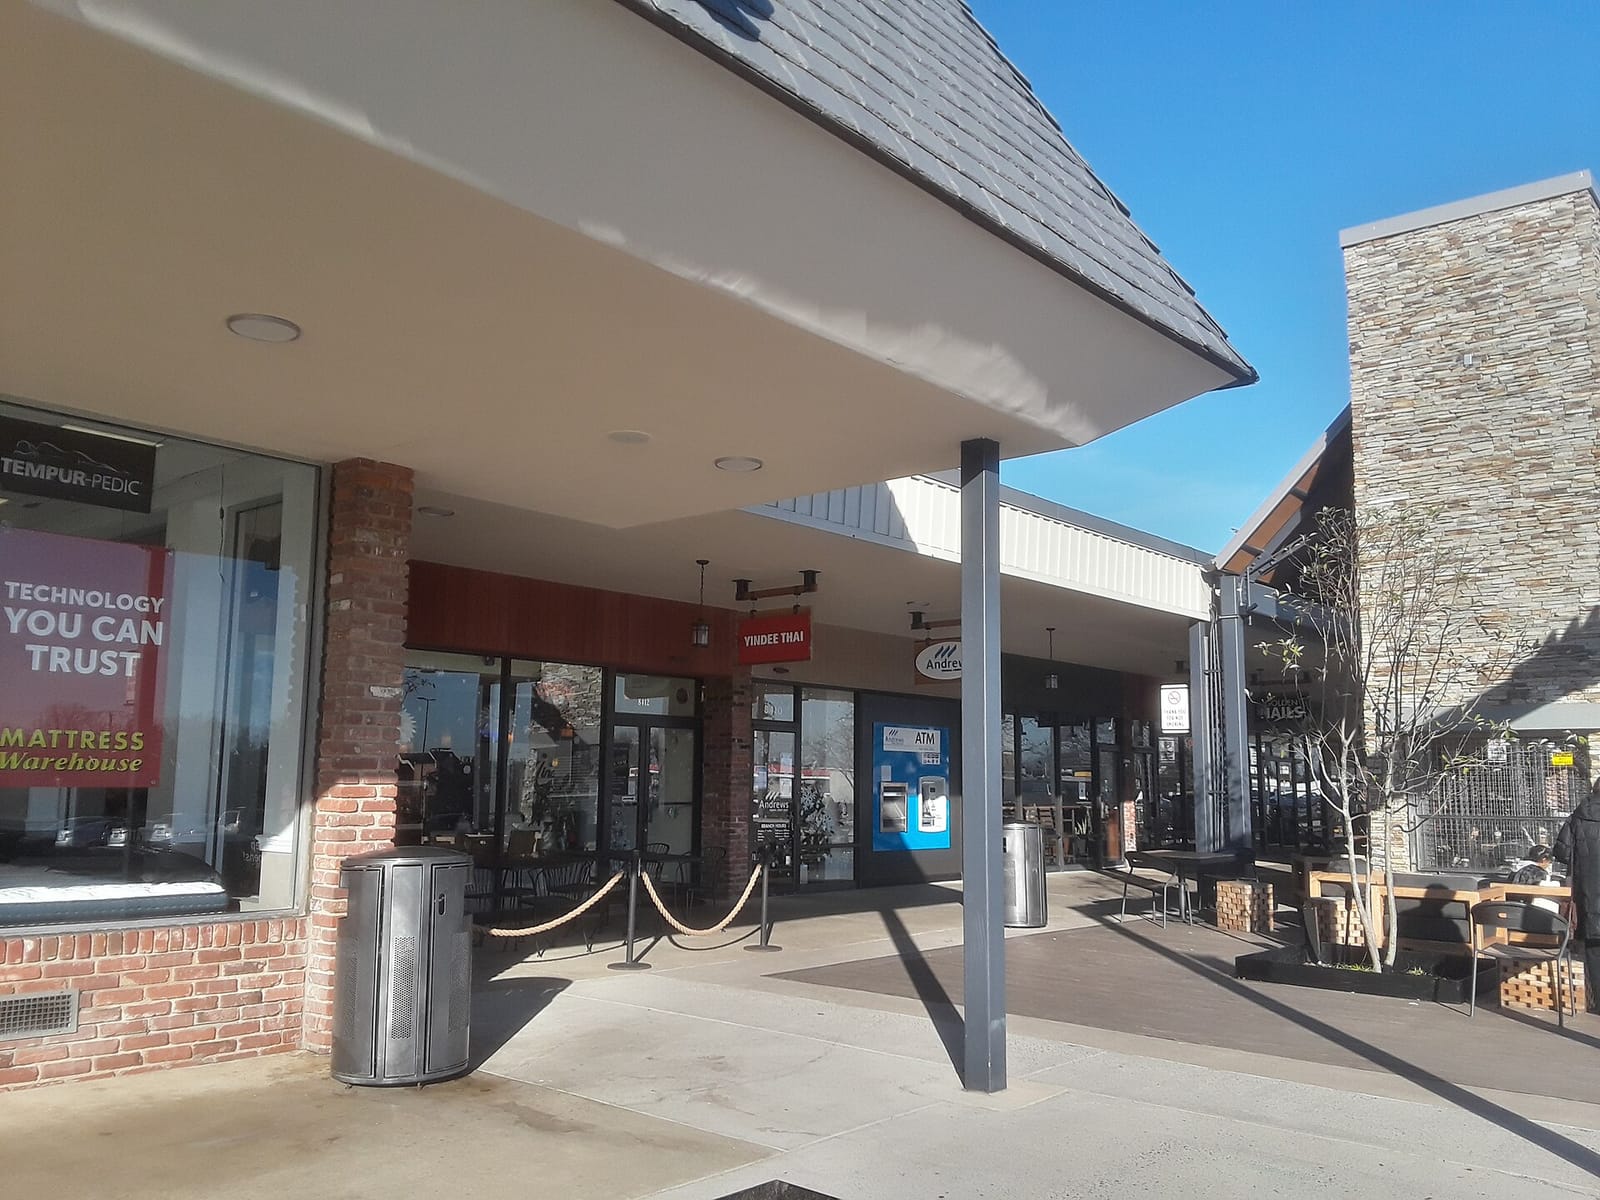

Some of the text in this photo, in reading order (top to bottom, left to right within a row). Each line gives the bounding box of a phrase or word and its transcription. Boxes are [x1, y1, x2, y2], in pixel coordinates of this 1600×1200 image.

[0, 457, 140, 496] TEMPUR-PEDIC
[4, 581, 165, 613] TECHNOLOGY
[3, 606, 164, 646] YOU CAN
[744, 630, 804, 647] YINDEE THAI
[24, 644, 141, 677] TRUST
[0, 728, 144, 751] MATTRESS
[915, 731, 935, 744] ATM
[0, 751, 143, 772] Warehouse
[758, 799, 789, 809] Andrews
